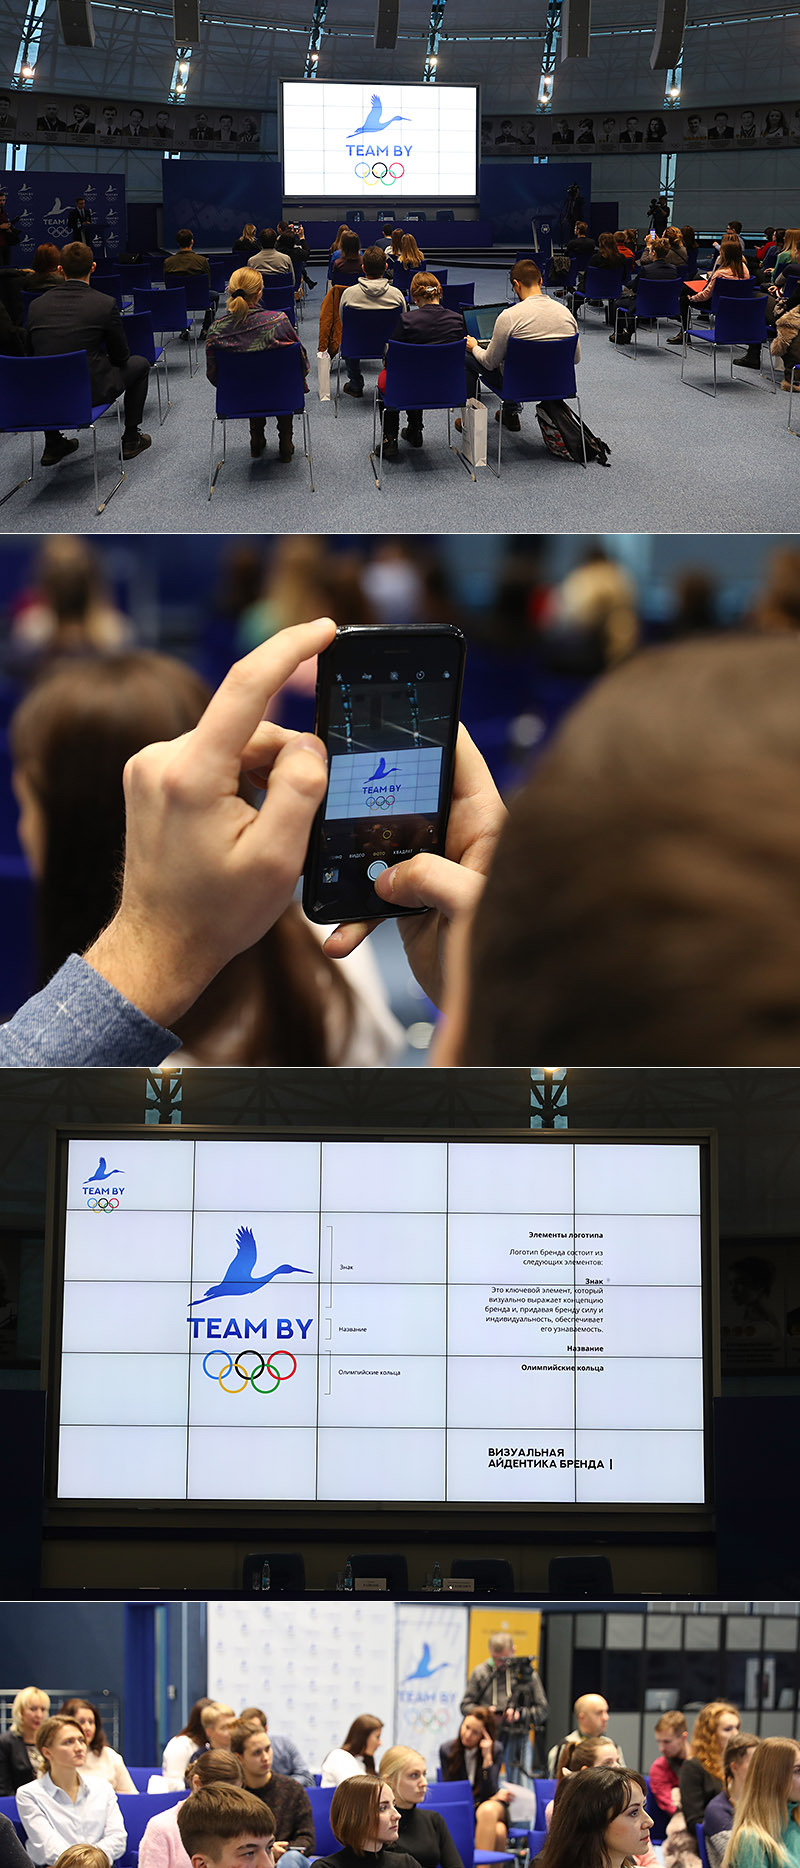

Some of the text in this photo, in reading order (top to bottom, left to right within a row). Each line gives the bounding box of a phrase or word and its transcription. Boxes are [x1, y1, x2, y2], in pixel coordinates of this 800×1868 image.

[346, 145, 413, 156] TEAM BY
[362, 786, 387, 794] TEAM
[82, 1187, 125, 1195] TEAM BY
[528, 1231, 567, 1239] Элементы
[509, 1249, 539, 1257] Логотип
[540, 1249, 566, 1257] бренда
[522, 1259, 564, 1267] следующих
[491, 1286, 504, 1294] Это
[505, 1286, 541, 1294] ключевой
[574, 1287, 604, 1295] который
[484, 1305, 511, 1313] бренда
[554, 1306, 581, 1314] бренду
[485, 1316, 554, 1324] индивидуальность,
[187, 1318, 313, 1339] TEAM BY
[521, 1363, 575, 1371] Олимпийские
[488, 1448, 565, 1457] ВИЗУАЛЬНАЯ
[488, 1457, 605, 1470] АЙДЕНТИКА БРЕНДА
[397, 1689, 436, 1703] TEAM
